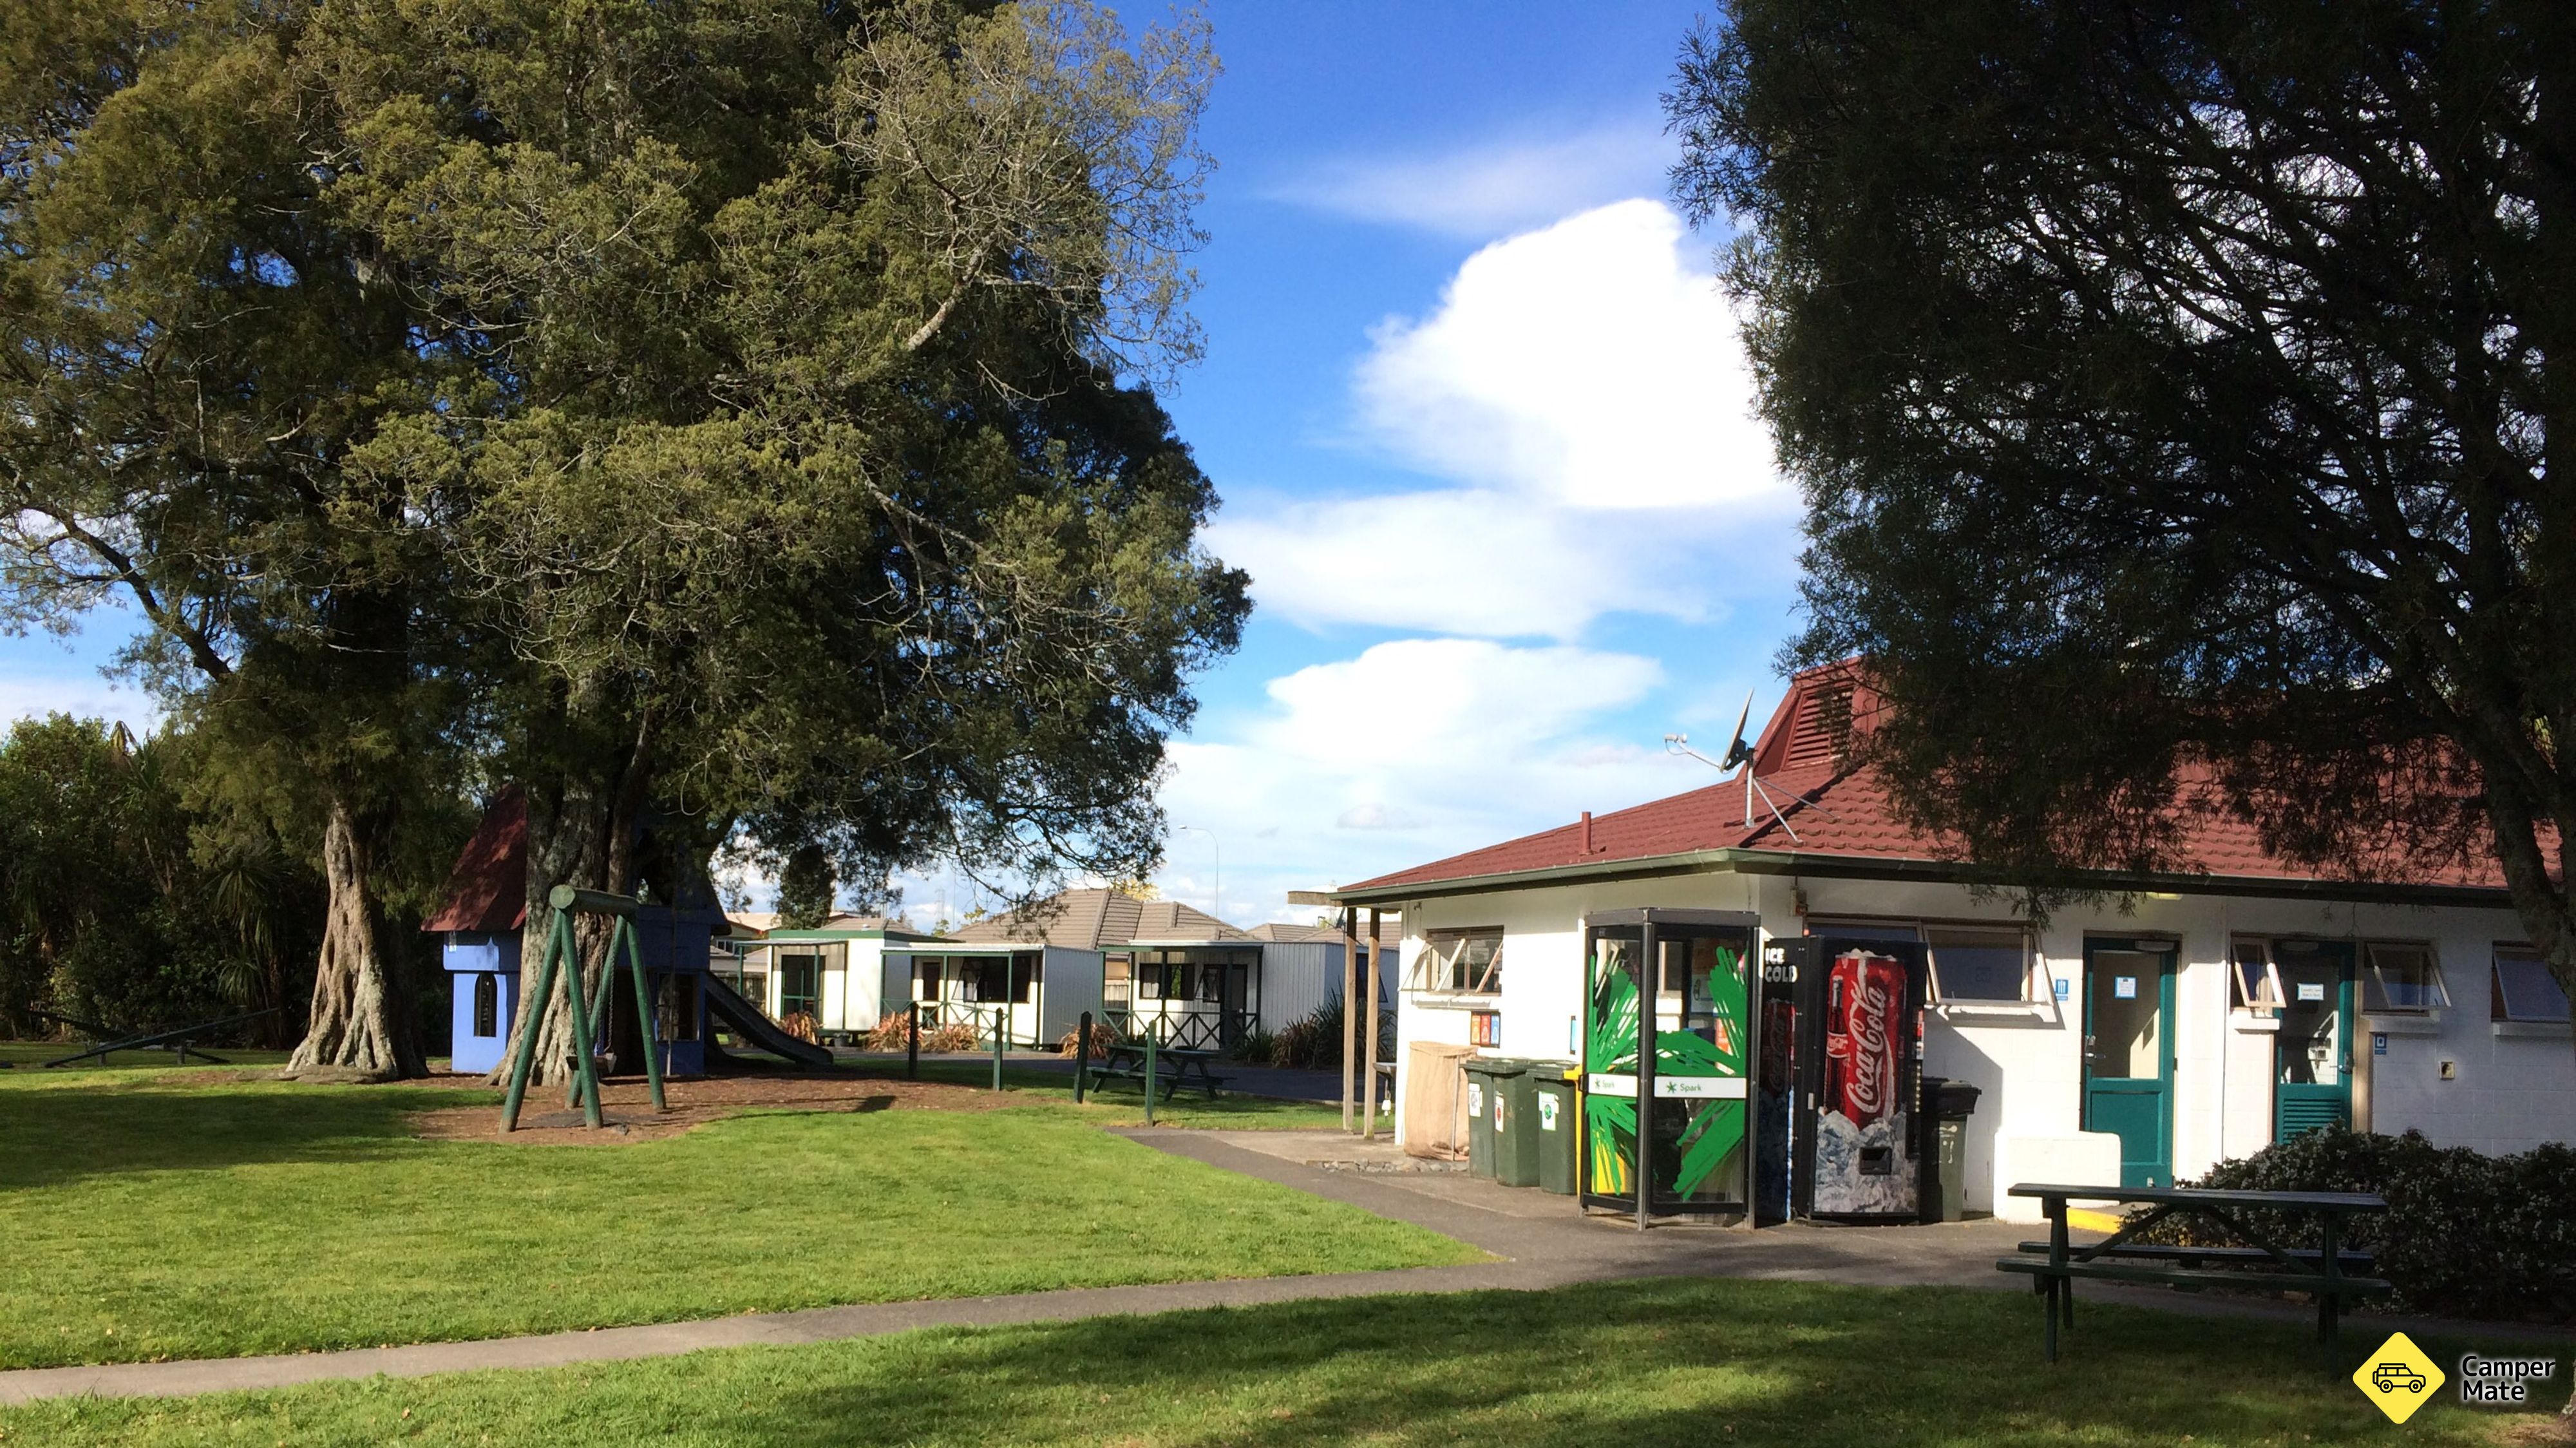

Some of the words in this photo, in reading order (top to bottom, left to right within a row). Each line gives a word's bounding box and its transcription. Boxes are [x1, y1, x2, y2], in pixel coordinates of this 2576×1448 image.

[1765, 948, 1785, 964] ICE
[1765, 965, 1798, 983] COLD
[1846, 980, 1886, 1113] Coca-Cola
[1680, 1083, 1701, 1092] Spark
